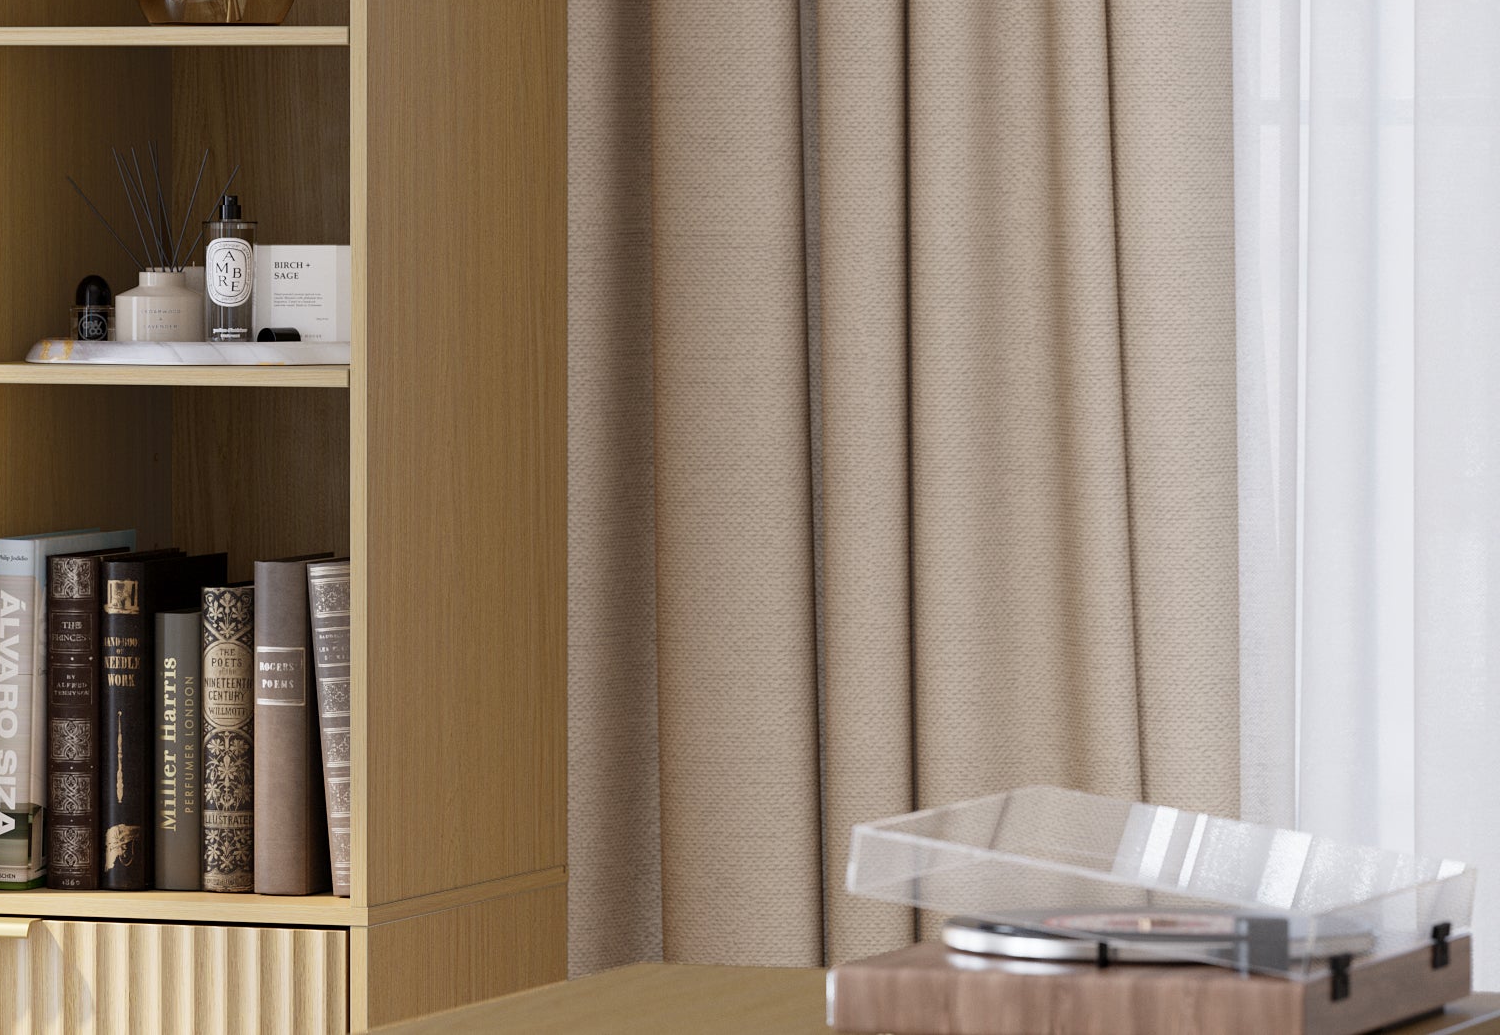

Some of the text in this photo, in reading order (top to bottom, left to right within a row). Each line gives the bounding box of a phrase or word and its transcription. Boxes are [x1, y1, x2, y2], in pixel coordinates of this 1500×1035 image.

[274, 272, 300, 280] SAGE
[212, 658, 243, 667] POETS
[260, 662, 294, 671] ROGERS
[108, 674, 135, 687] WORK
[262, 679, 294, 689] POEMS
[208, 691, 246, 701] CENTURY
[160, 657, 177, 831] Miller Harris
[185, 676, 194, 813] PERFUMER LONDON
